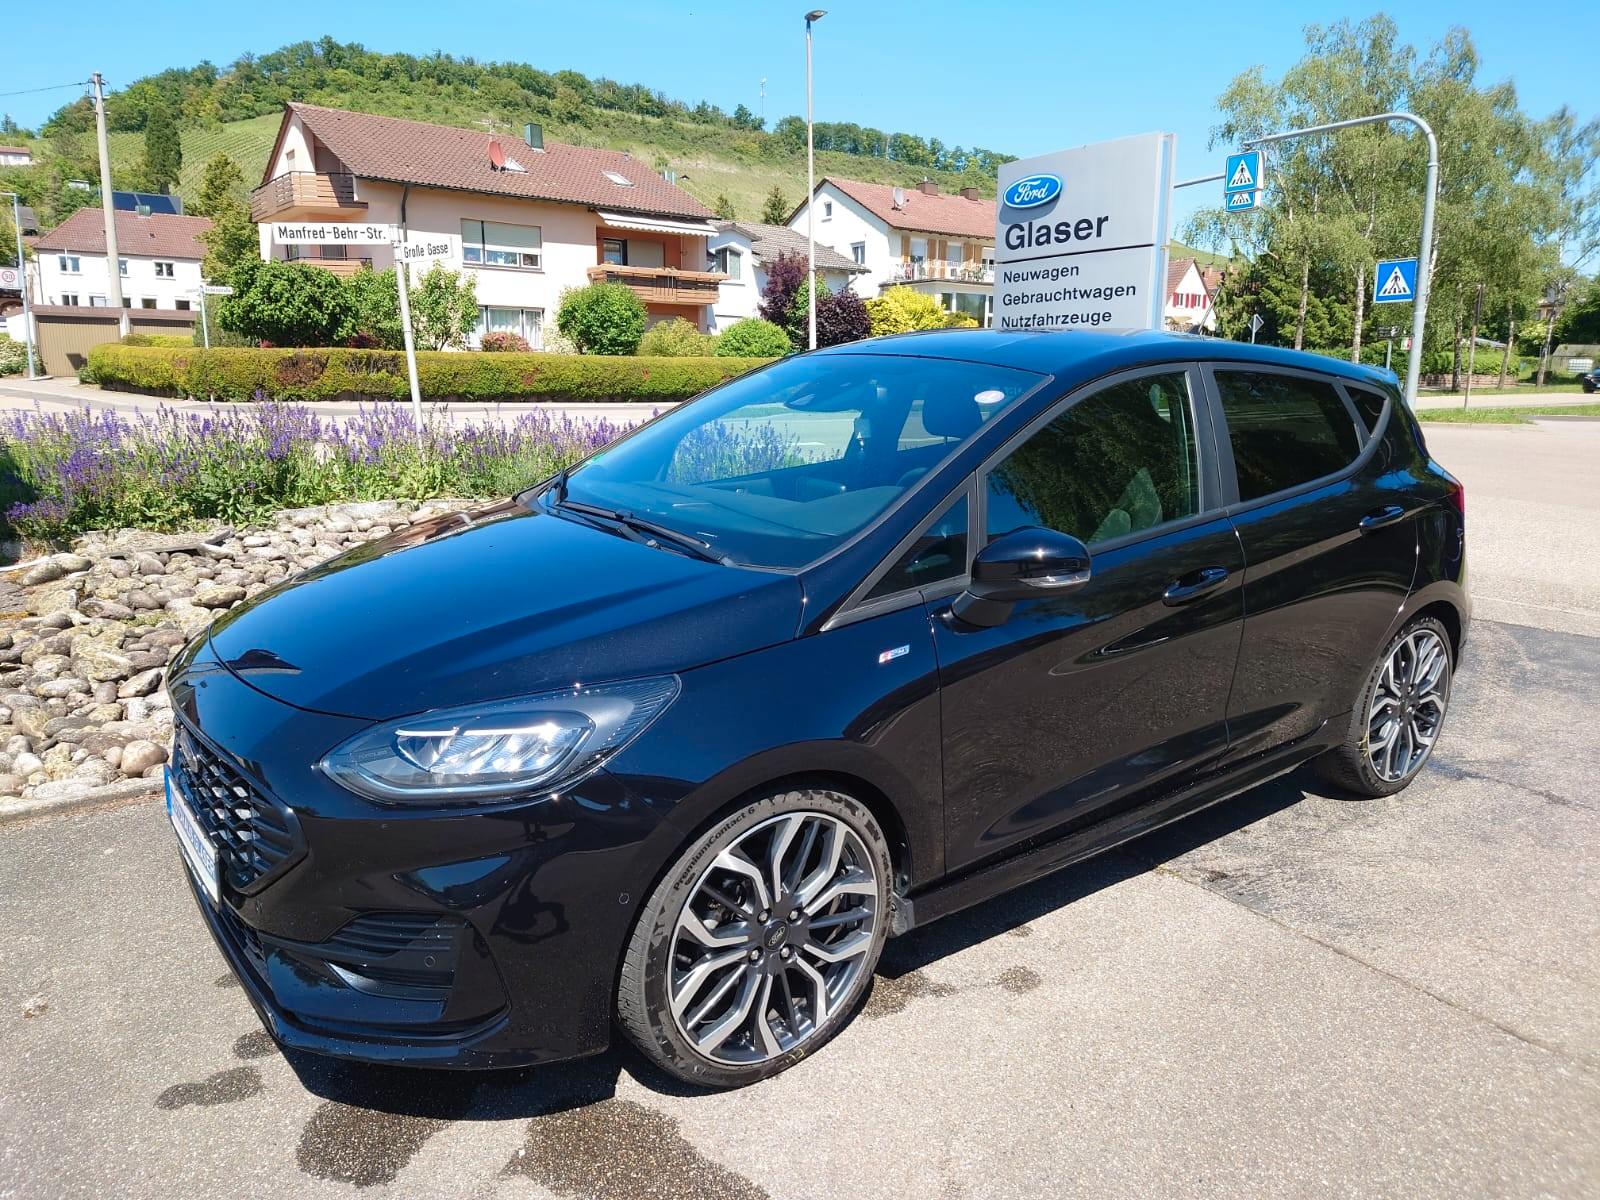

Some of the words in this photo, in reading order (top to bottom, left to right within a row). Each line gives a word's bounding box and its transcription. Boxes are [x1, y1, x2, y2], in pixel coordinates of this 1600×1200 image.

[278, 226, 387, 240] Manfred-Behr-Str.
[1005, 215, 1109, 250] Glaser
[403, 245, 425, 259] Große
[427, 243, 449, 256] Gasse
[1003, 265, 1080, 284] Neuwagen
[1002, 285, 1137, 306] Gebrauchtwagen
[1001, 310, 1113, 329] Nutzfahrzeuge
[673, 812, 747, 891] PremiumContact
